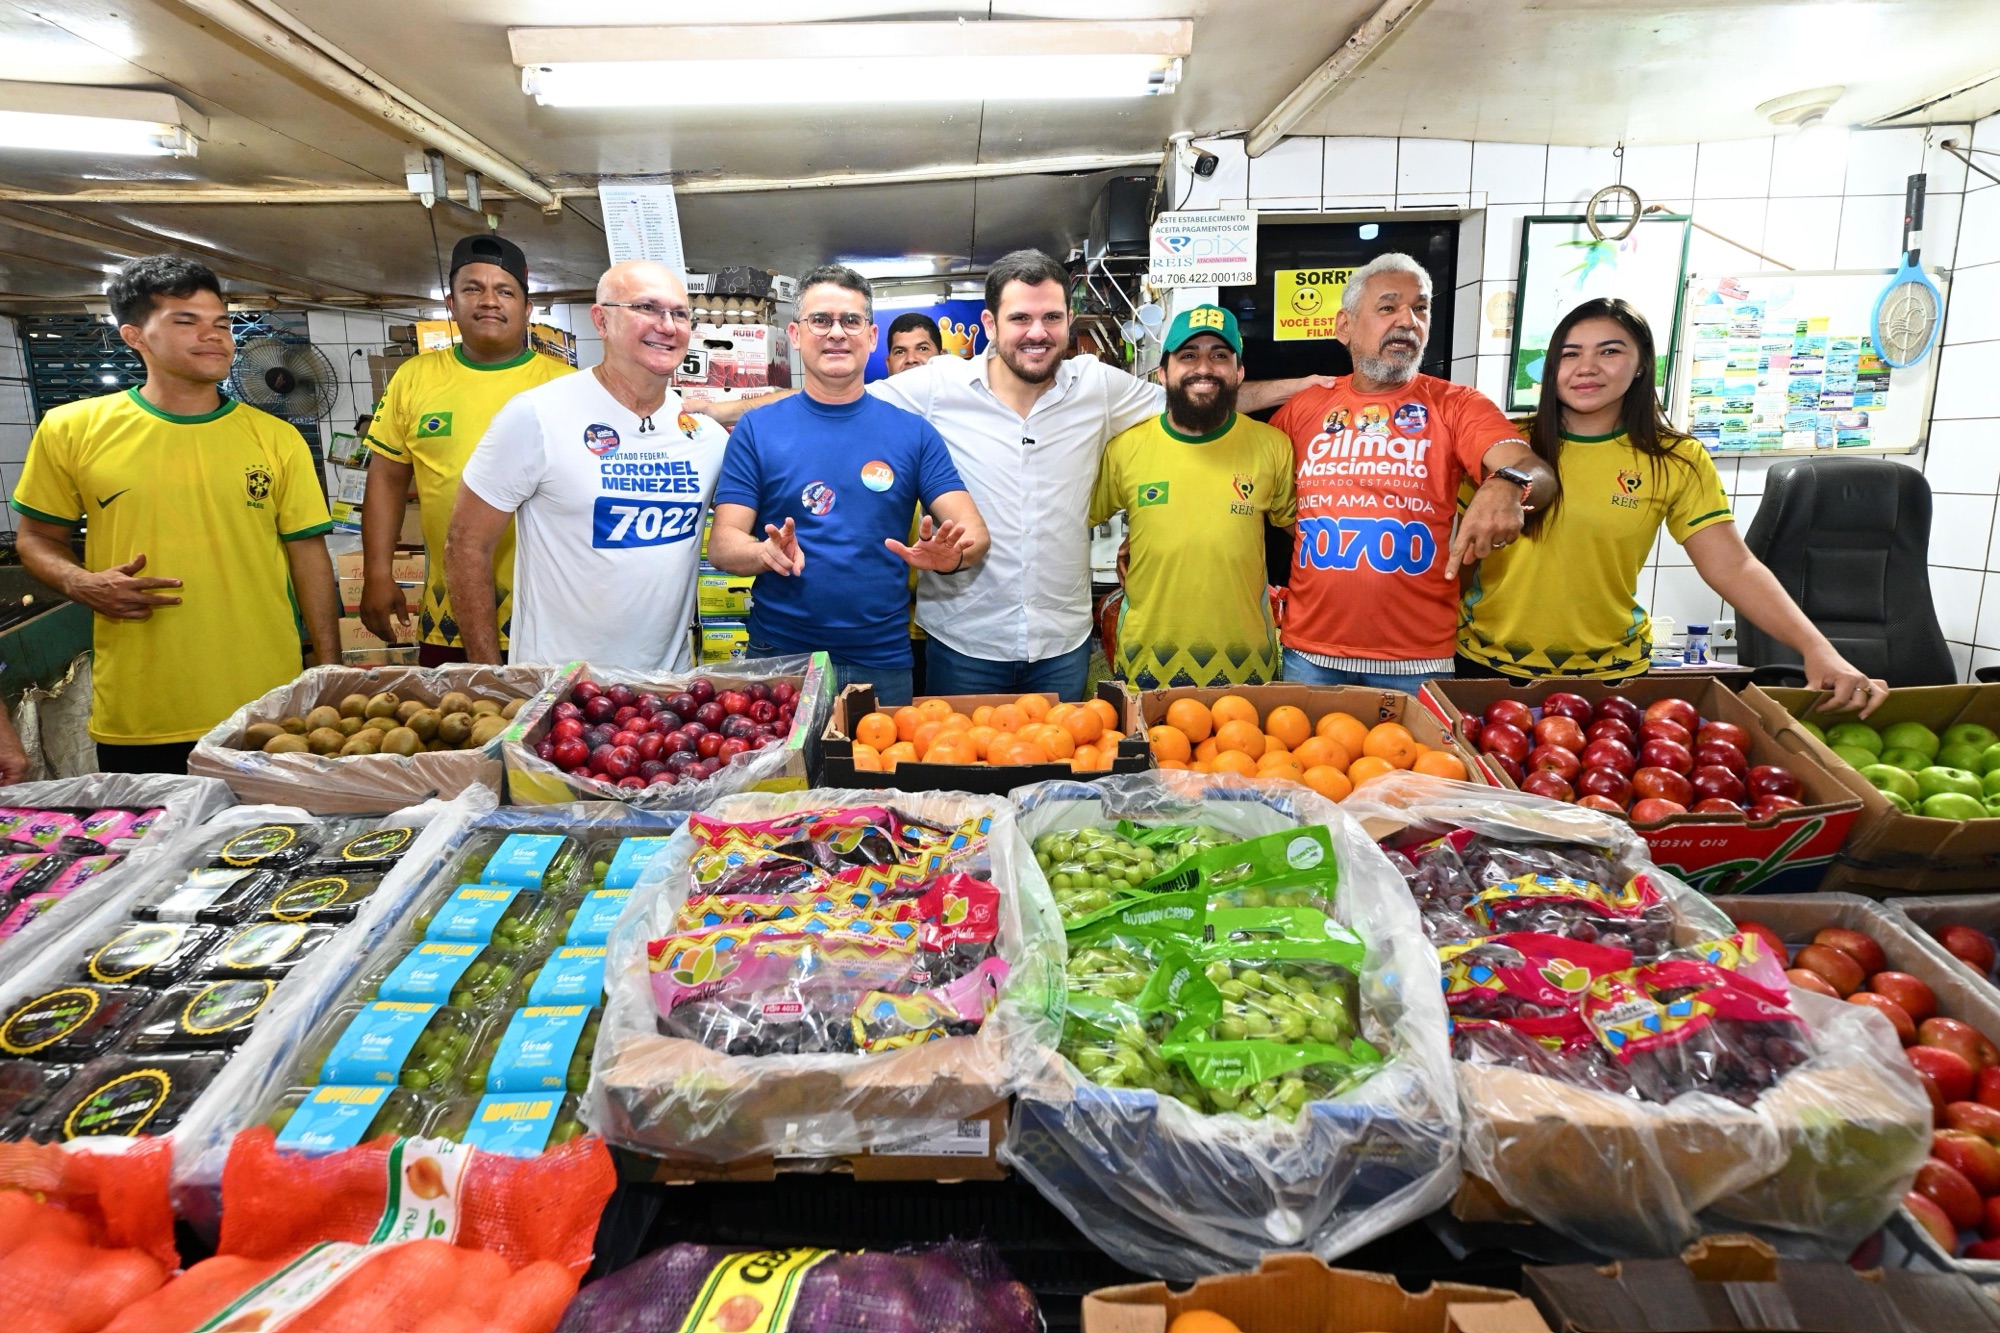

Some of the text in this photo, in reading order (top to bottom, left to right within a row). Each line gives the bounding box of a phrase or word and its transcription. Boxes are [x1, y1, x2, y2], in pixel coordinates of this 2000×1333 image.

[1160, 215, 1246, 224] ESTE ESTABELECIMENTO
[1181, 225, 1232, 233] PAGAMENTOS
[1192, 234, 1249, 264] pix
[1153, 257, 1193, 268] REIS
[1150, 271, 1253, 285] 04.706.422.0001/38
[1279, 317, 1335, 328] VOCÊ EST
[732, 329, 755, 338] RUBI
[683, 354, 701, 375] 5
[1307, 429, 1432, 462] Gilmar
[639, 452, 670, 460] FEDERAL
[600, 460, 699, 476] CORONEL
[875, 466, 890, 478] 70
[1298, 457, 1428, 479] Nascimento
[601, 477, 701, 493] MENEZES
[1359, 478, 1426, 491] ESTADUAL
[1336, 494, 1378, 508] AMA
[1383, 494, 1436, 514] CUIDA
[1610, 495, 1640, 510] REIS
[1230, 503, 1255, 517] REIS
[605, 505, 699, 542] 7022
[393, 565, 424, 579] Selecio
[395, 627, 416, 638] Selec
[711, 632, 734, 640] FORTALEZA
[1649, 838, 1729, 849] RIO NEGR
[512, 848, 539, 859] Verde
[631, 853, 655, 863] Verd
[451, 914, 479, 925] Verde
[409, 969, 440, 980] Verde
[555, 972, 587, 983] Verde
[782, 1003, 800, 1013] 4022
[361, 1033, 394, 1045] Verde
[520, 1040, 554, 1053] Verde
